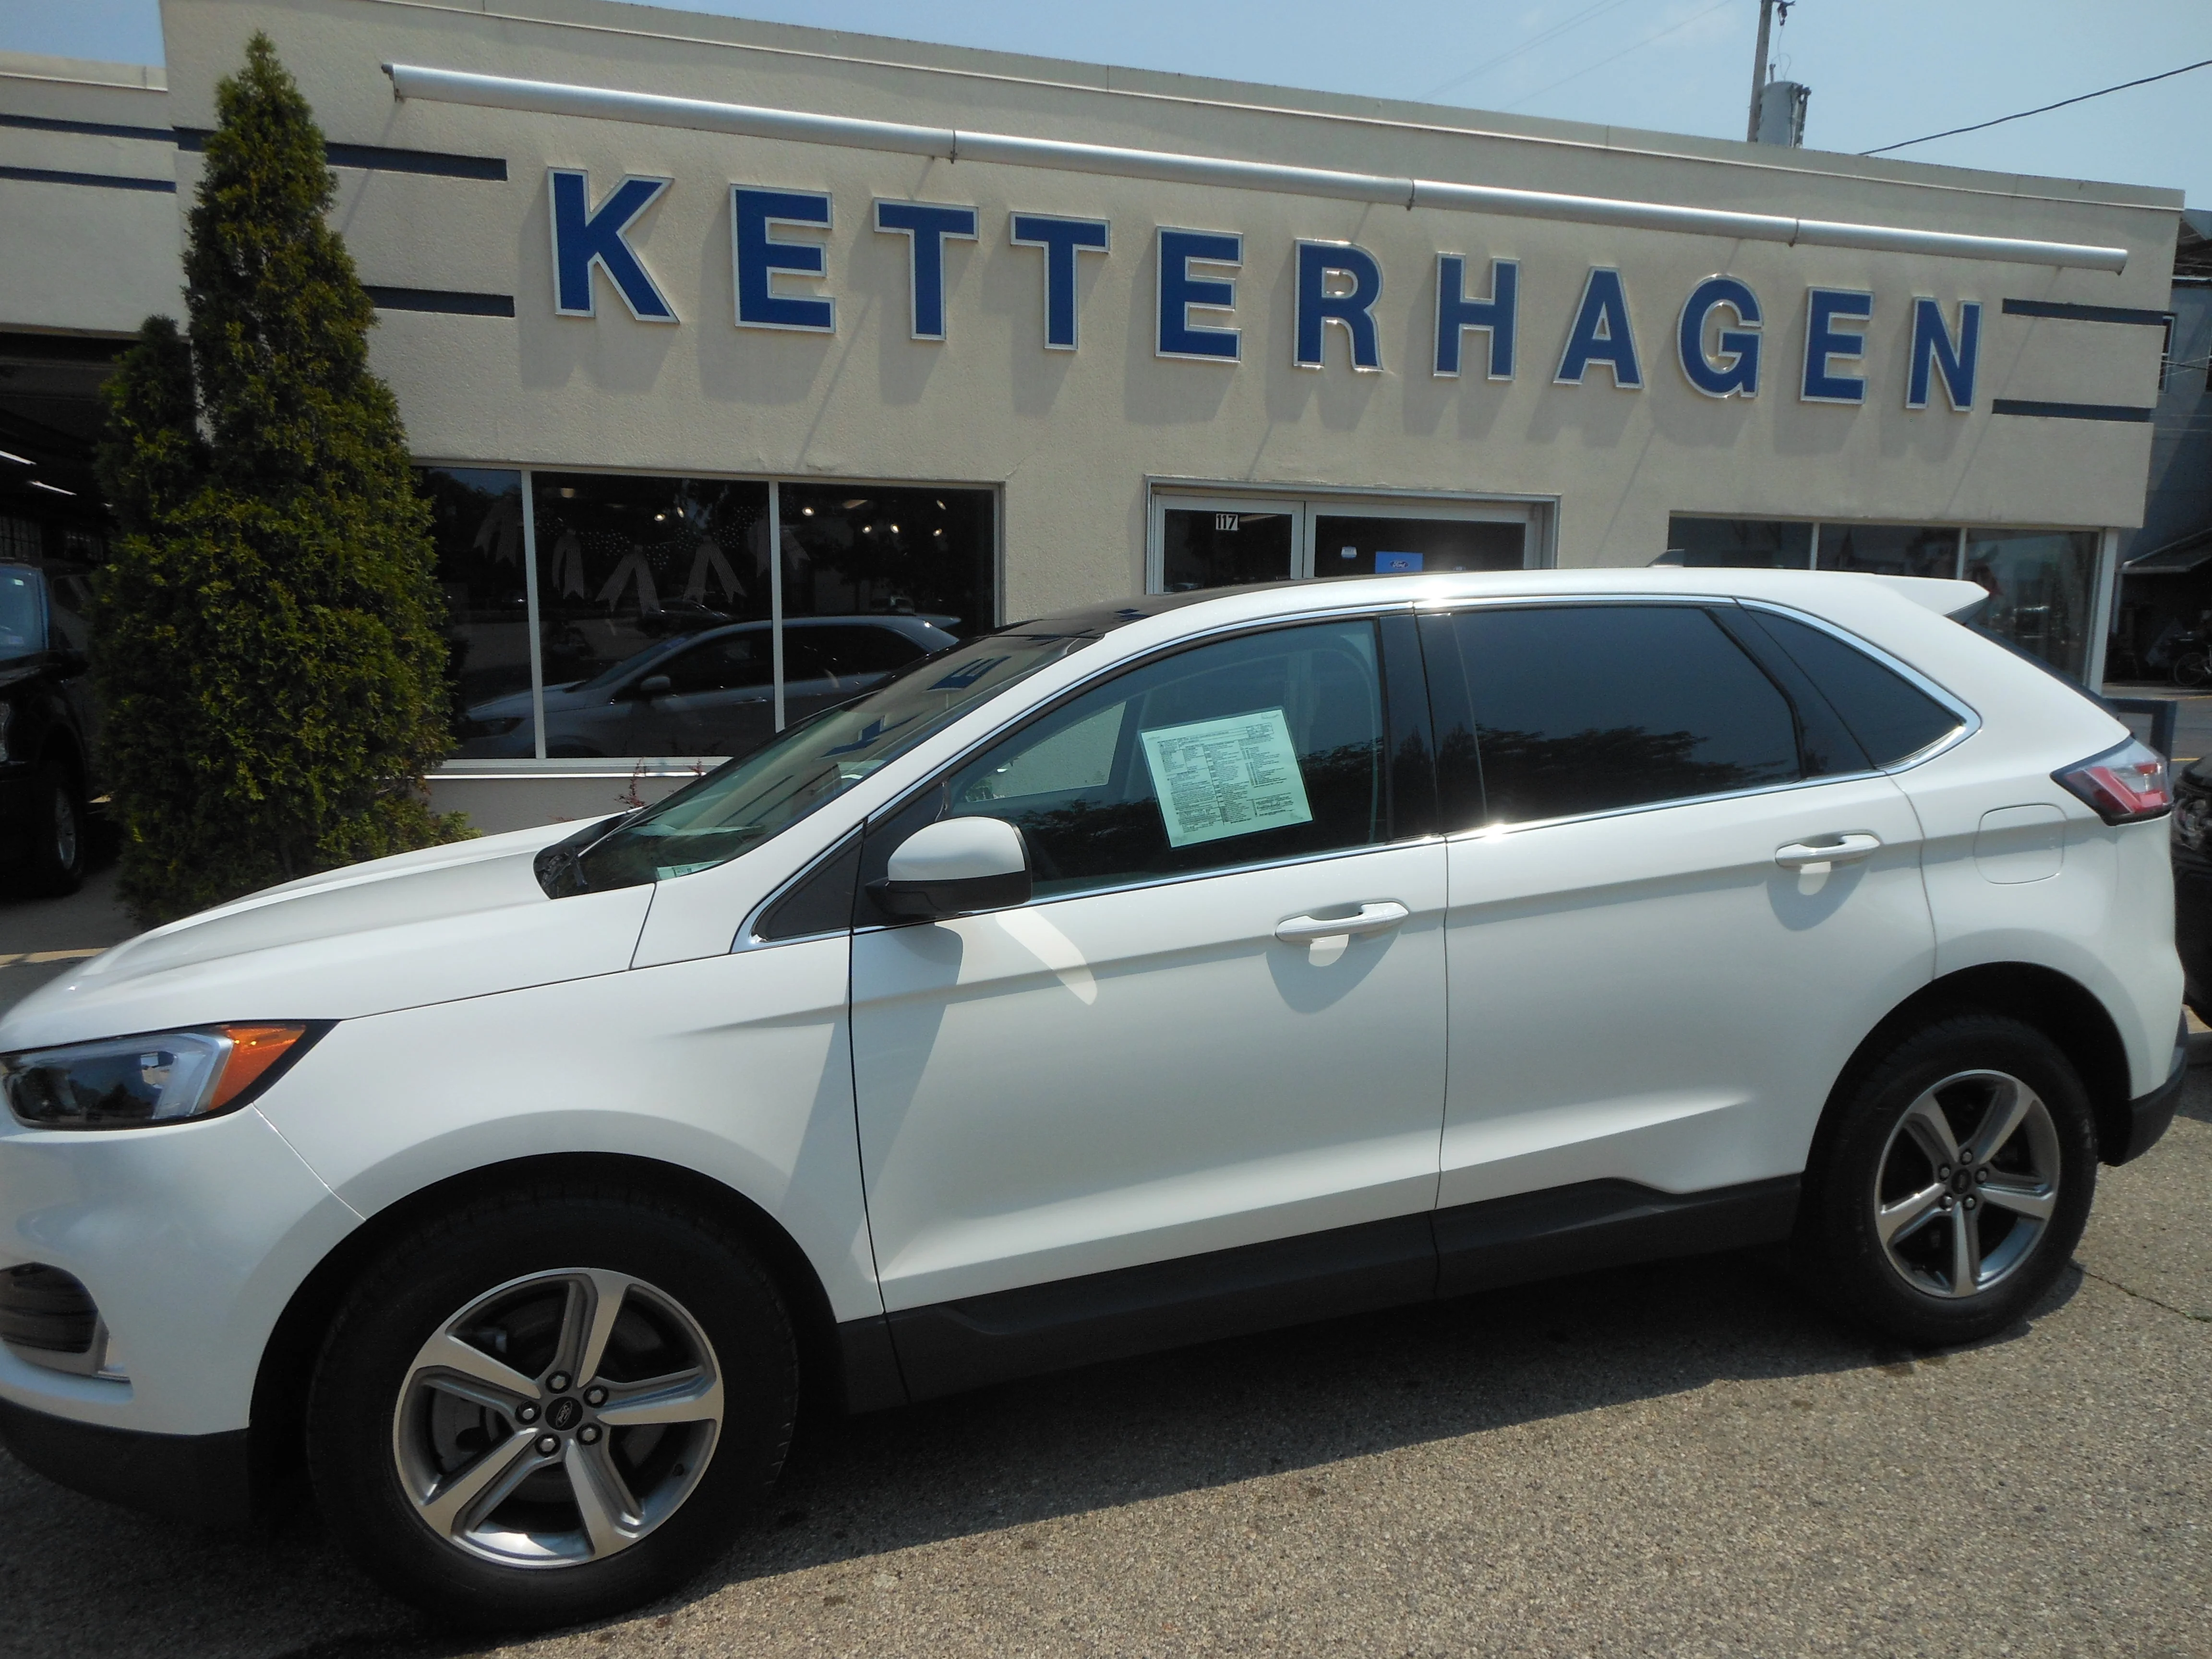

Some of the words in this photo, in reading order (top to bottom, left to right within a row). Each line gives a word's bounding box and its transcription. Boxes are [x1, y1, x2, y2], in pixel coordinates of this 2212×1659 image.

[547, 167, 1984, 413] KETTERHAGEN
[1217, 514, 1237, 529] 117
[558, 1405, 570, 1423] Ford
